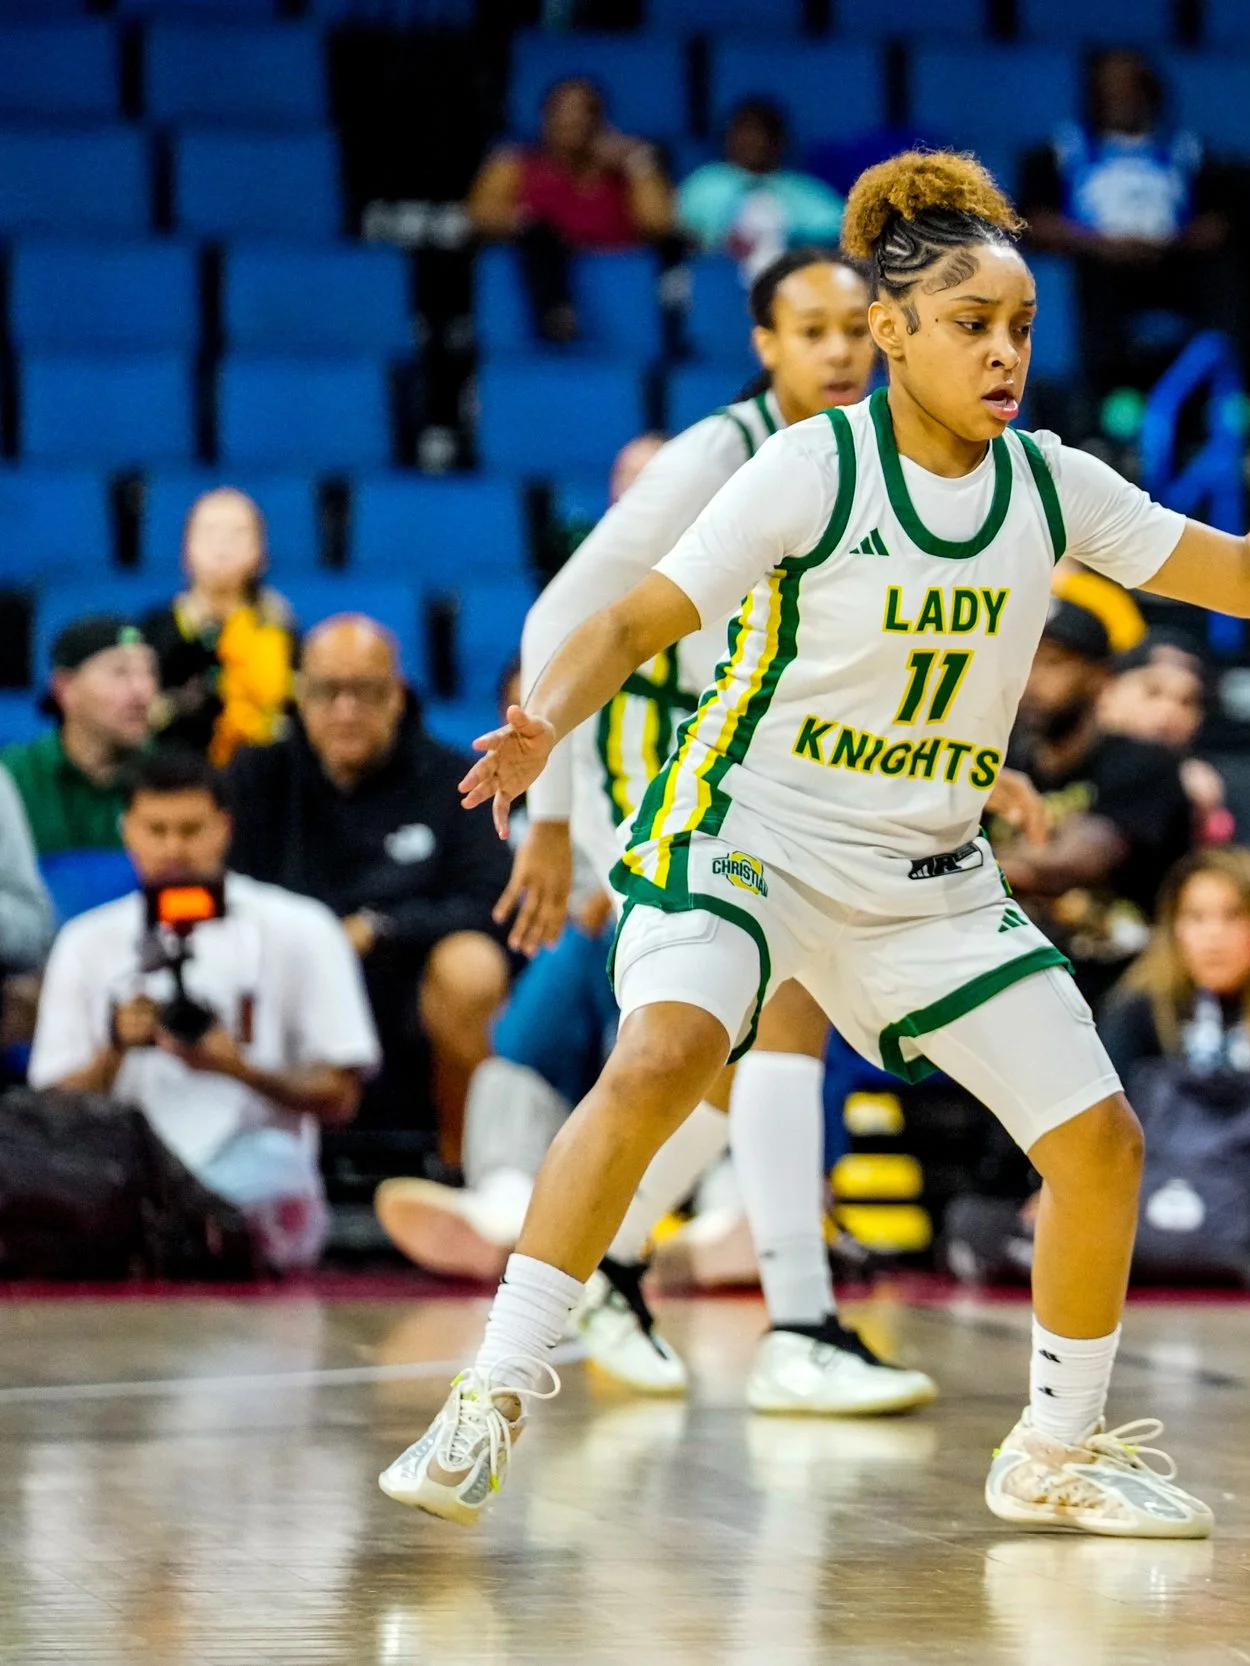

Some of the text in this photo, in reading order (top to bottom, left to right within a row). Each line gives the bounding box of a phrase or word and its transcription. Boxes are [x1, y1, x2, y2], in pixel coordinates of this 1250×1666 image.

[882, 585, 1011, 636] LADY
[892, 648, 975, 726] 11
[792, 714, 1003, 791] KNIGHTS
